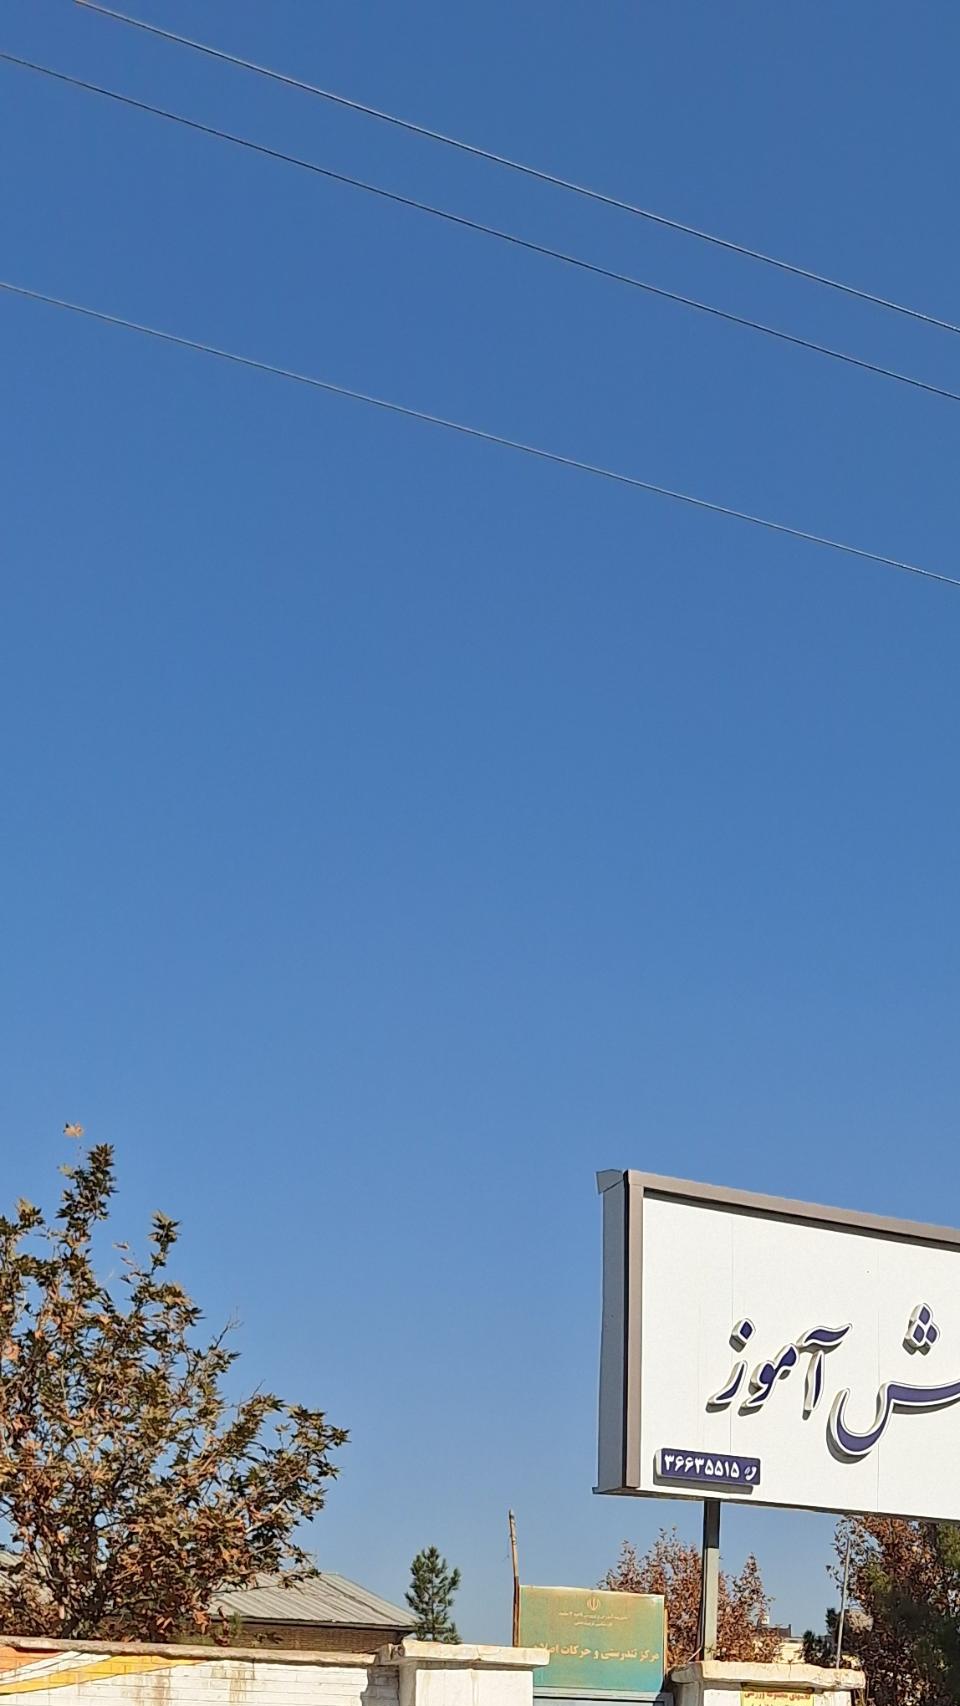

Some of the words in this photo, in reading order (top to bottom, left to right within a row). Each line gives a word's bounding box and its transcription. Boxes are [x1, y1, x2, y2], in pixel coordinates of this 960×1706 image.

[706, 1318, 852, 1412] آموز
[664, 1454, 740, 1479] ۳۶۶۳۵۵۱۵
[560, 1645, 591, 1658] حرکات
[594, 1650, 598, 1659] و
[601, 1648, 638, 1660] تندرستی
[640, 1650, 660, 1662] مرکز
